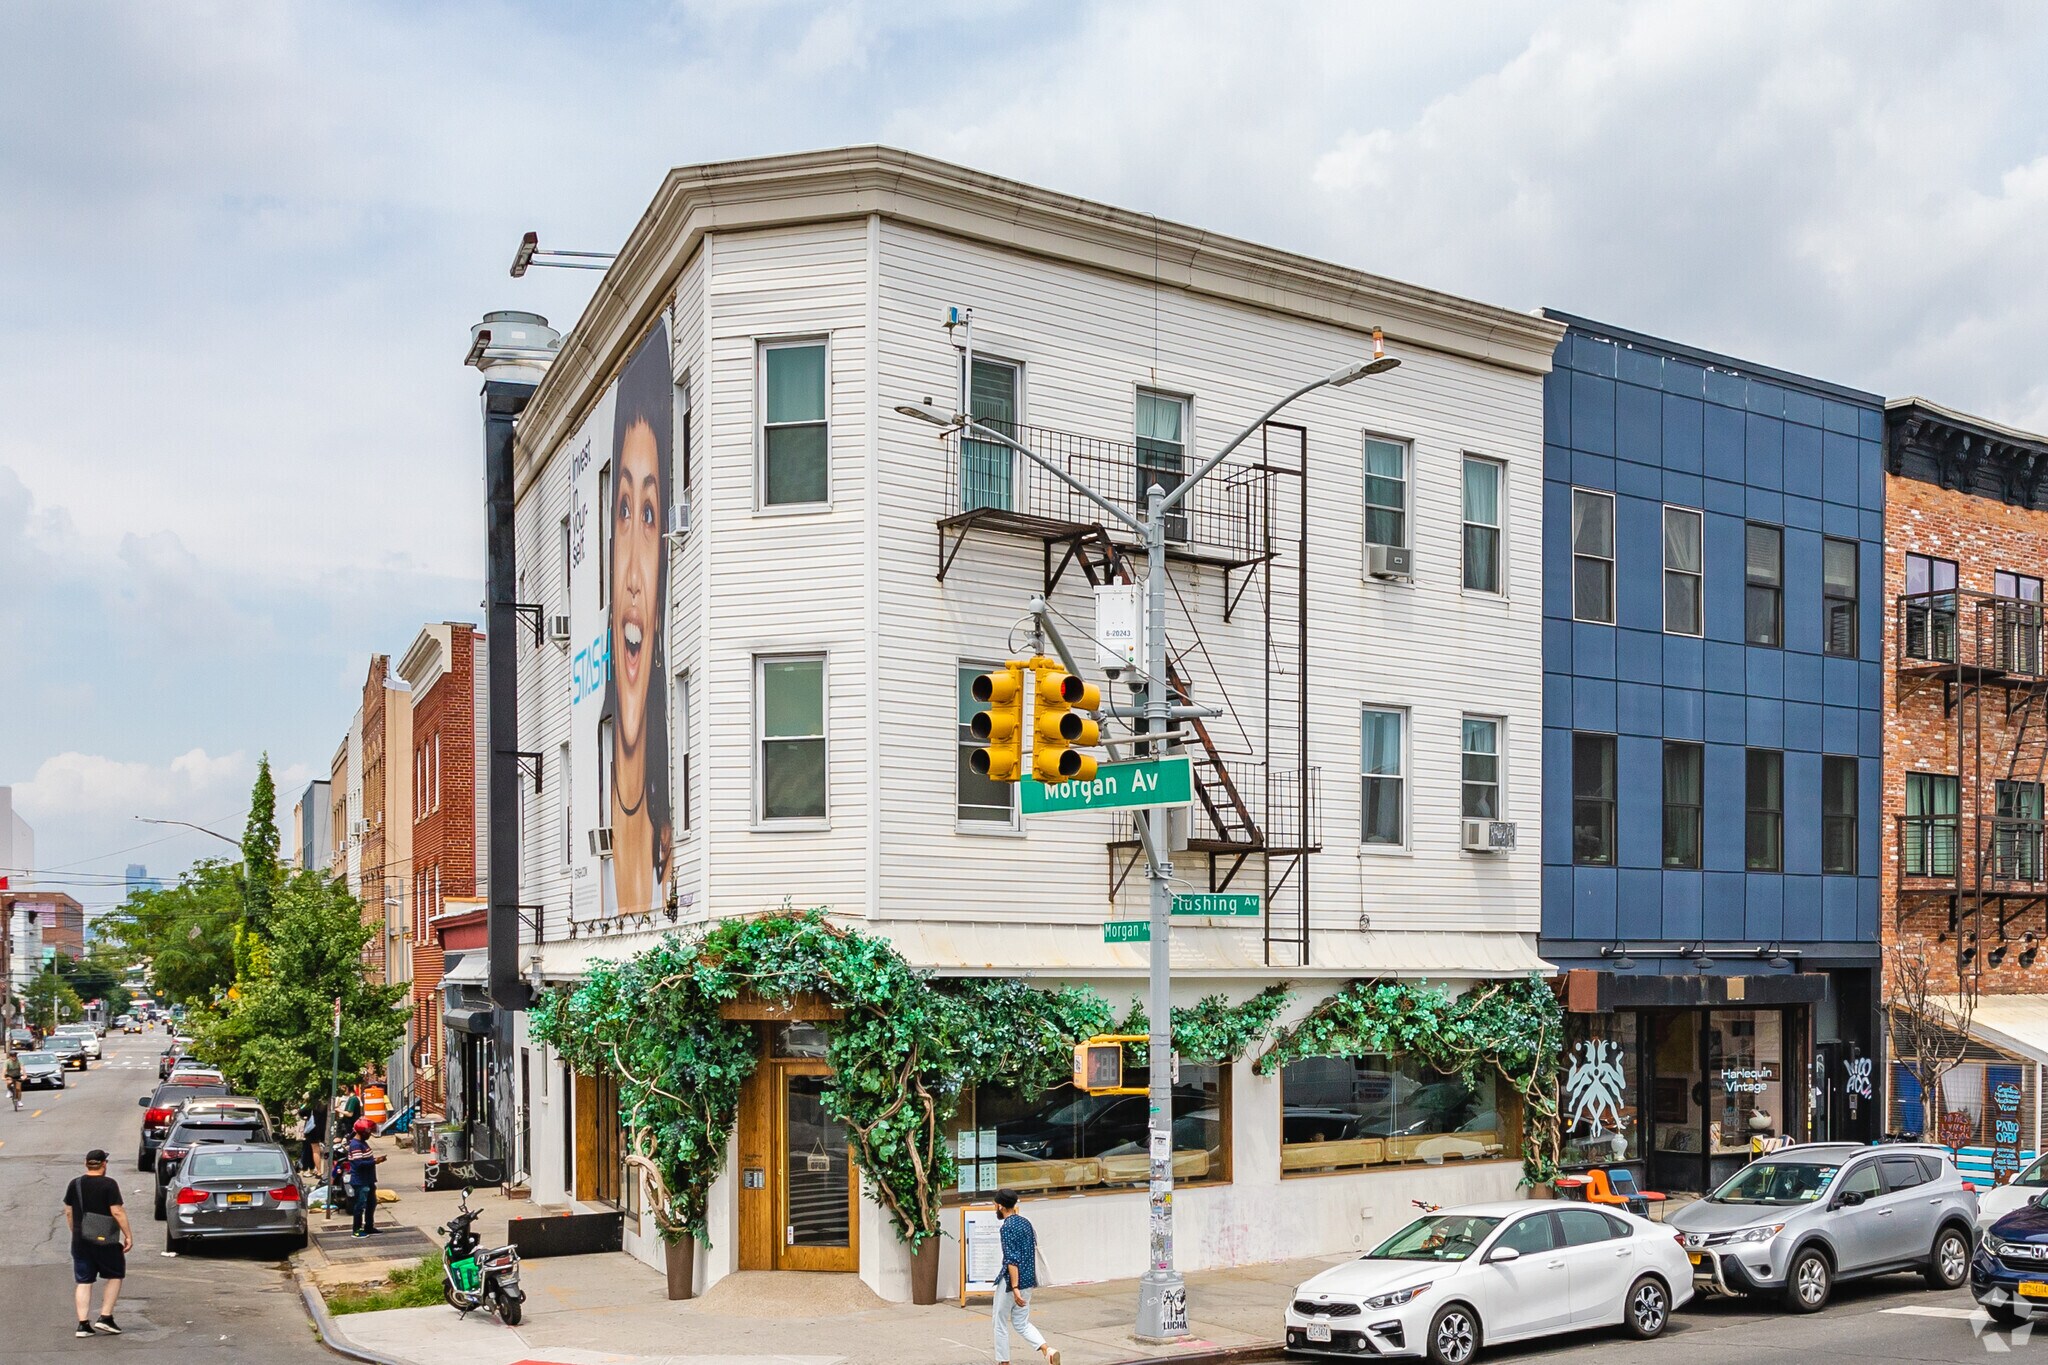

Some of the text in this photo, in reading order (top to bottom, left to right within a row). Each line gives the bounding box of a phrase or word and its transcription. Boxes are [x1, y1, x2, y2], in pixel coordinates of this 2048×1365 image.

[1105, 629, 1131, 638] 6-20243
[573, 627, 611, 706] STASH
[1044, 769, 1158, 805] Morgan Av
[1171, 895, 1258, 915] Flushing Av
[1104, 923, 1139, 941] Morgan
[1721, 1066, 1773, 1081] Harlequin
[1725, 1080, 1768, 1094] Vintage
[1995, 1119, 2020, 1133] PATIO
[1995, 1131, 2018, 1144] OPEN
[1163, 1320, 1188, 1330] LUCHA
